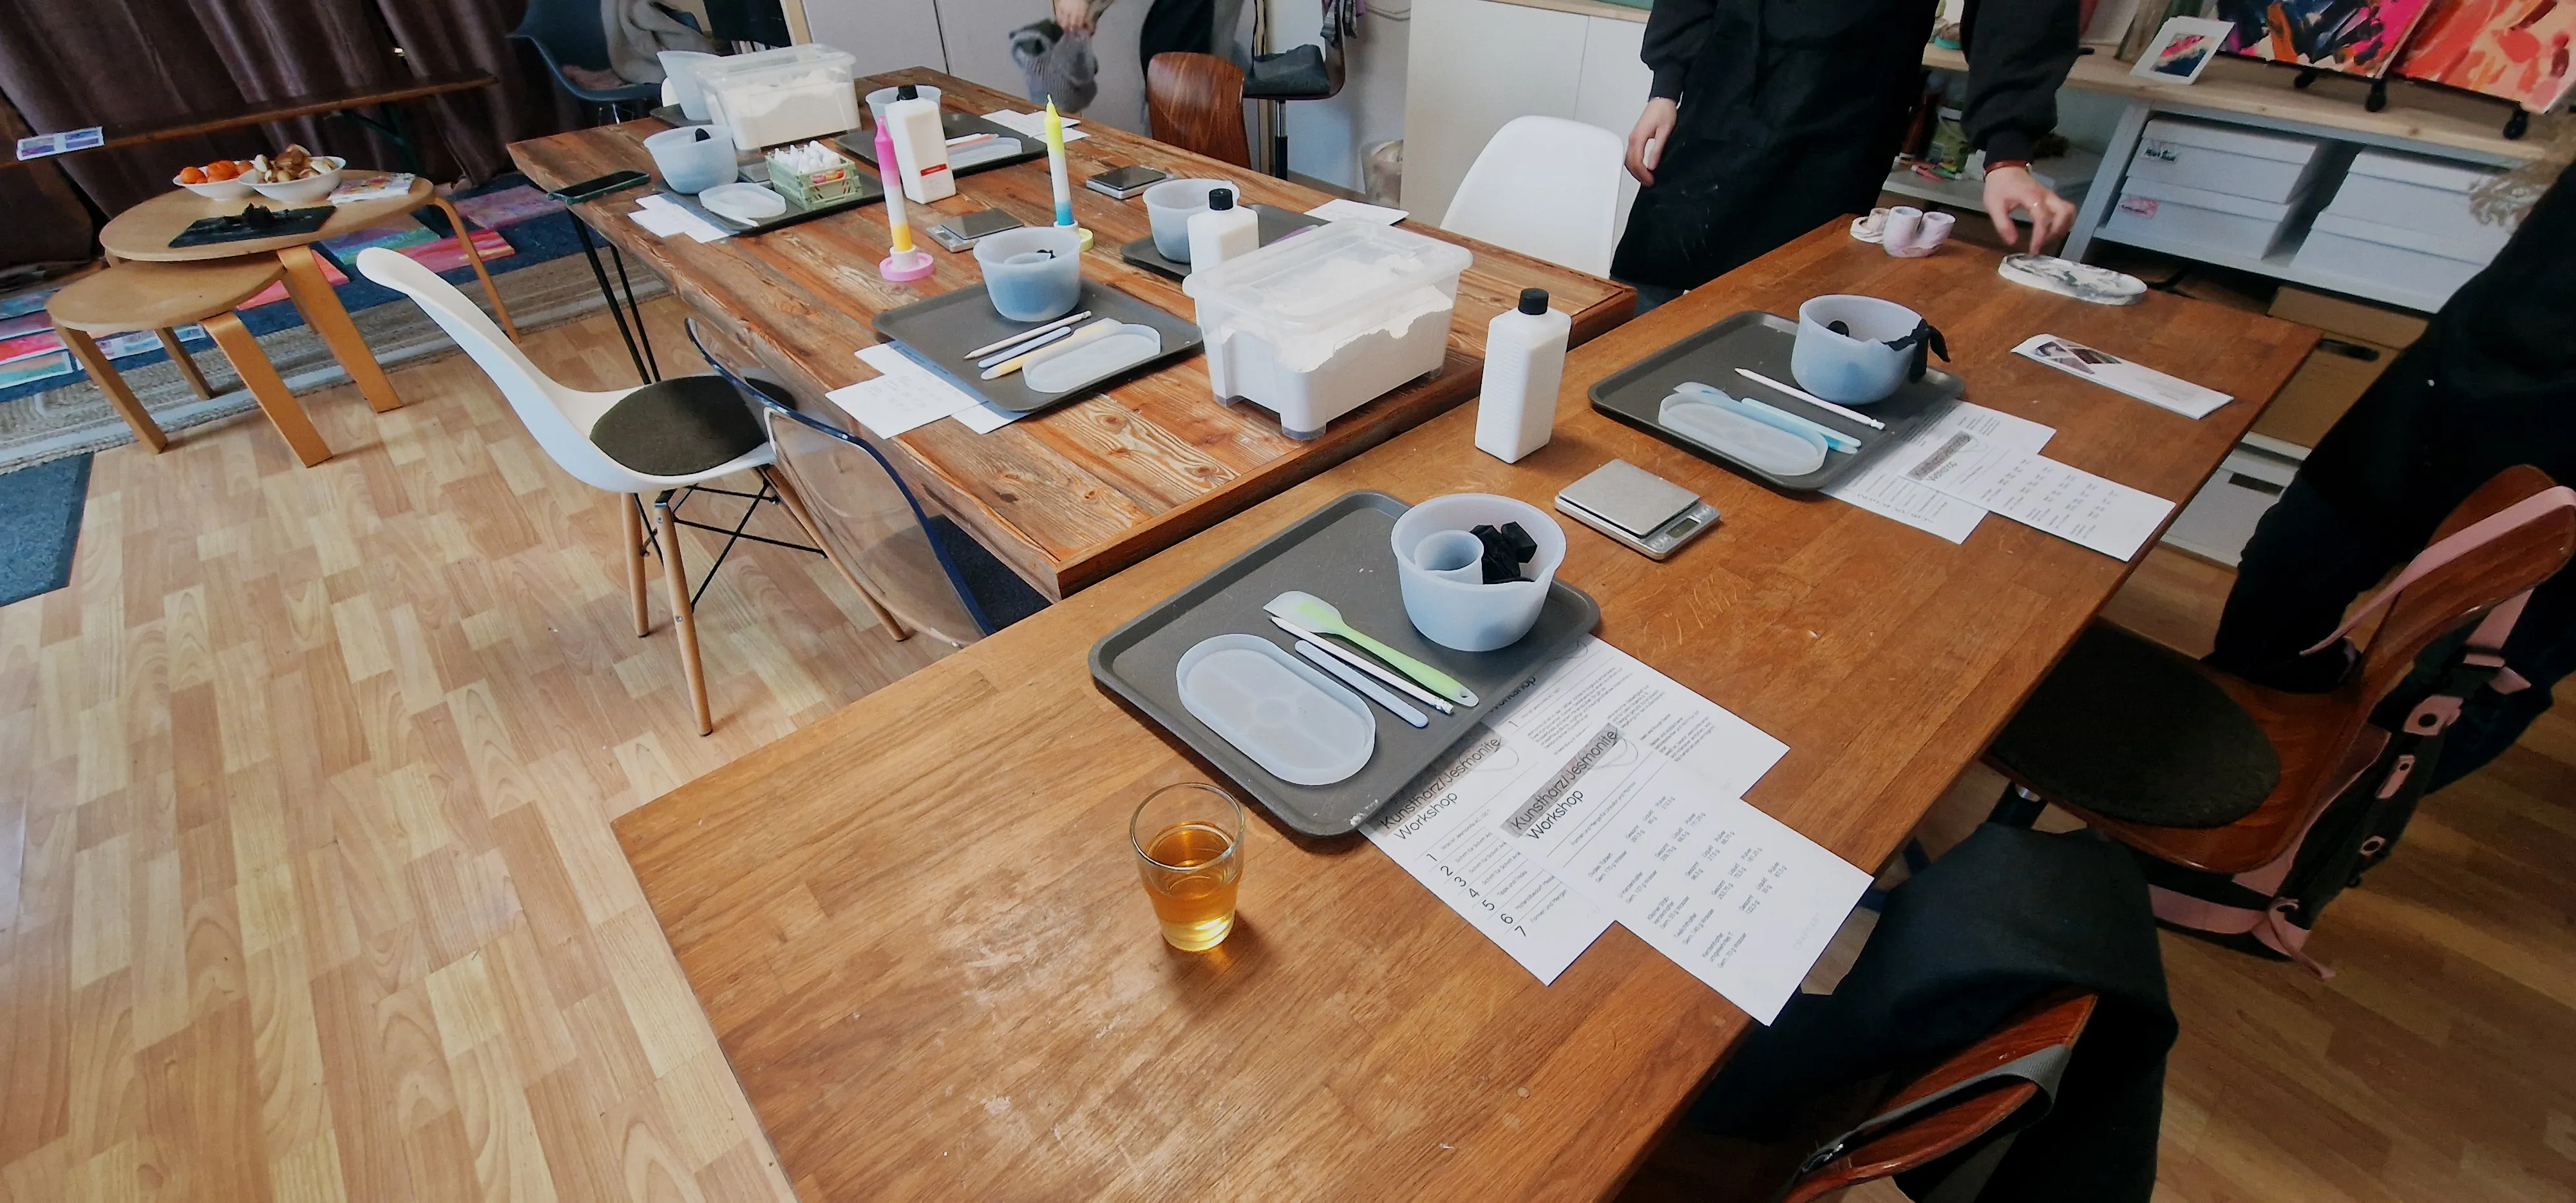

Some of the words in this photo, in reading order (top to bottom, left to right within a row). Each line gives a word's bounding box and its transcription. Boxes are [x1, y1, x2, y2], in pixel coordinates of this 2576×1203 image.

[1394, 793, 1457, 838] Workshop
[1527, 790, 1583, 838] Workshop
[1440, 866, 1453, 876] 2
[1454, 876, 1466, 887] 3
[1469, 888, 1479, 897] 4
[1482, 899, 1494, 911] 5
[1501, 913, 1513, 924] 6
[1514, 925, 1526, 936] 7
